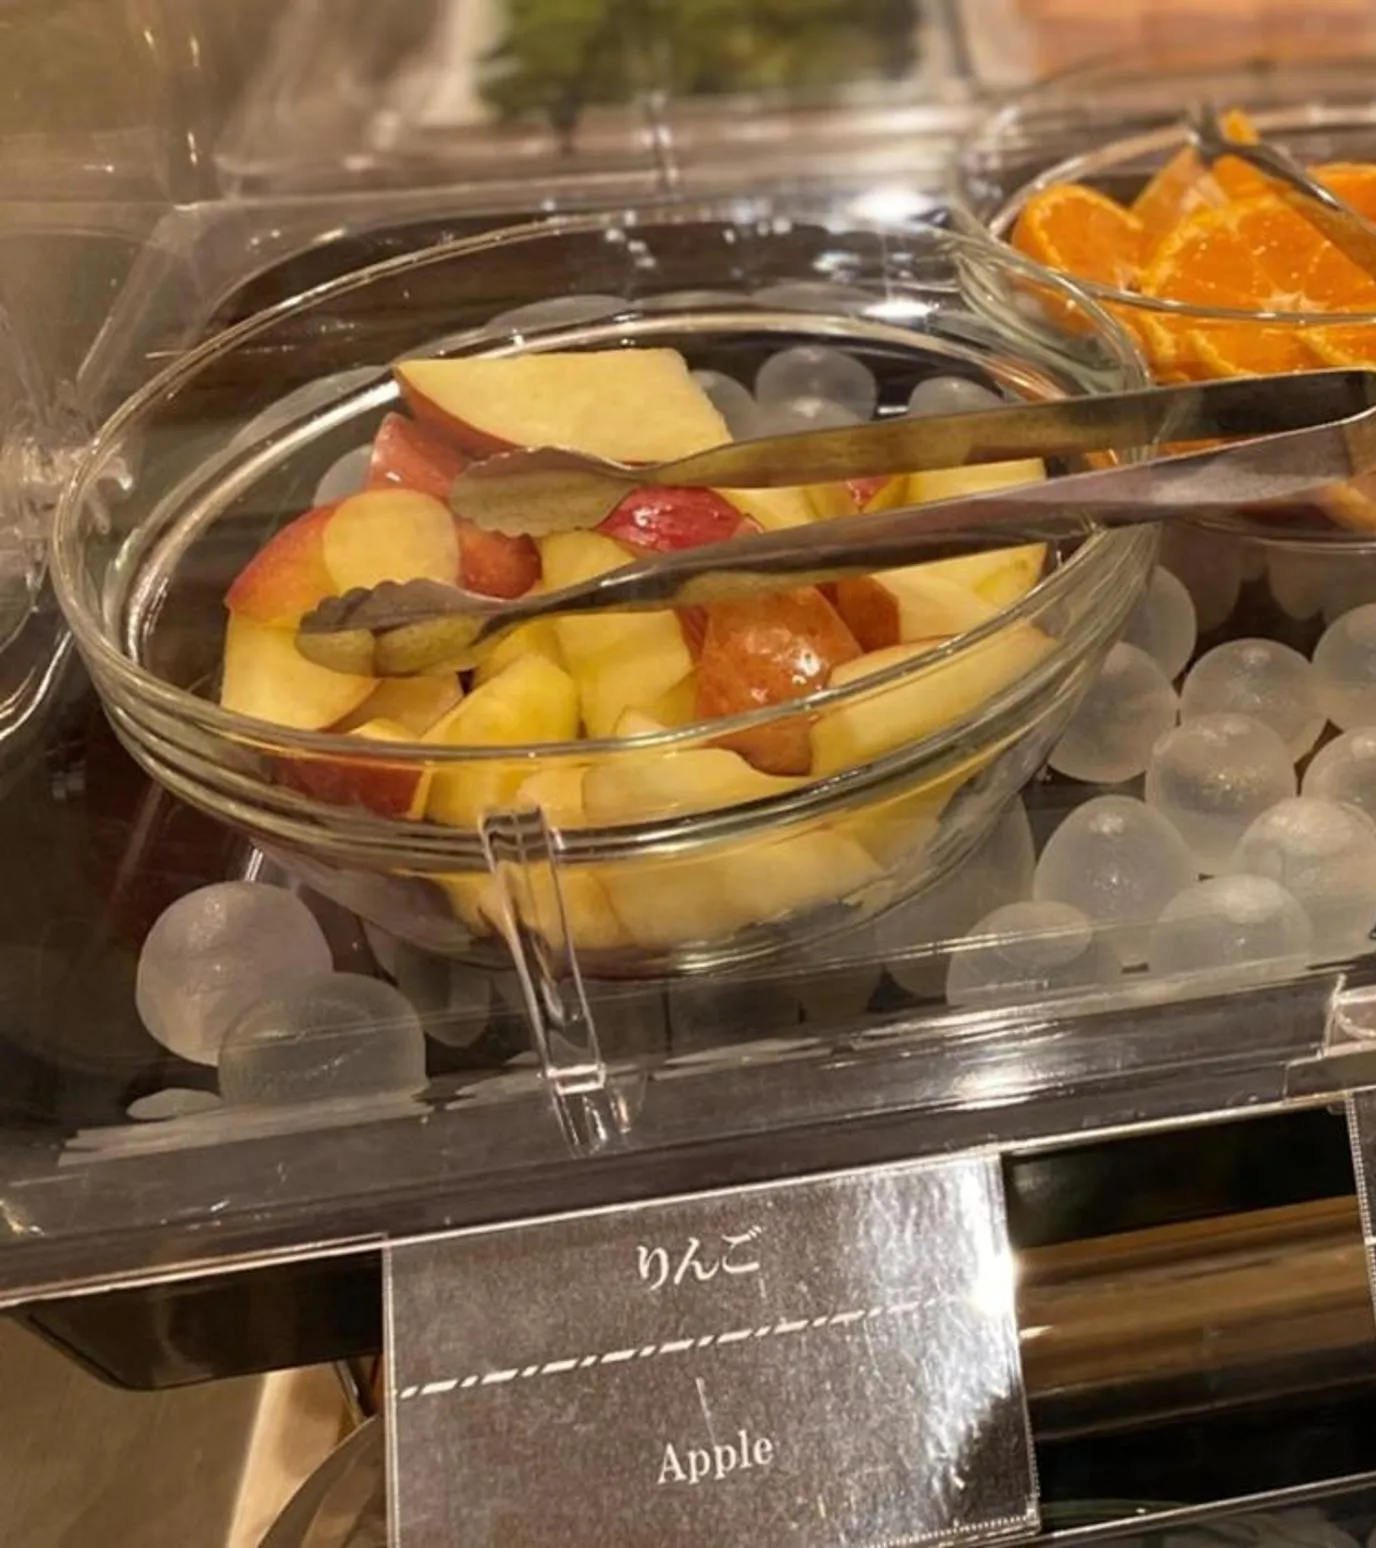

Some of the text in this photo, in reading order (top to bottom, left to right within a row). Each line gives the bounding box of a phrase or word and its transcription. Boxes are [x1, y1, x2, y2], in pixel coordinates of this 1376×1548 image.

[635, 1225, 763, 1291] りんご
[657, 1429, 775, 1485] Apple
